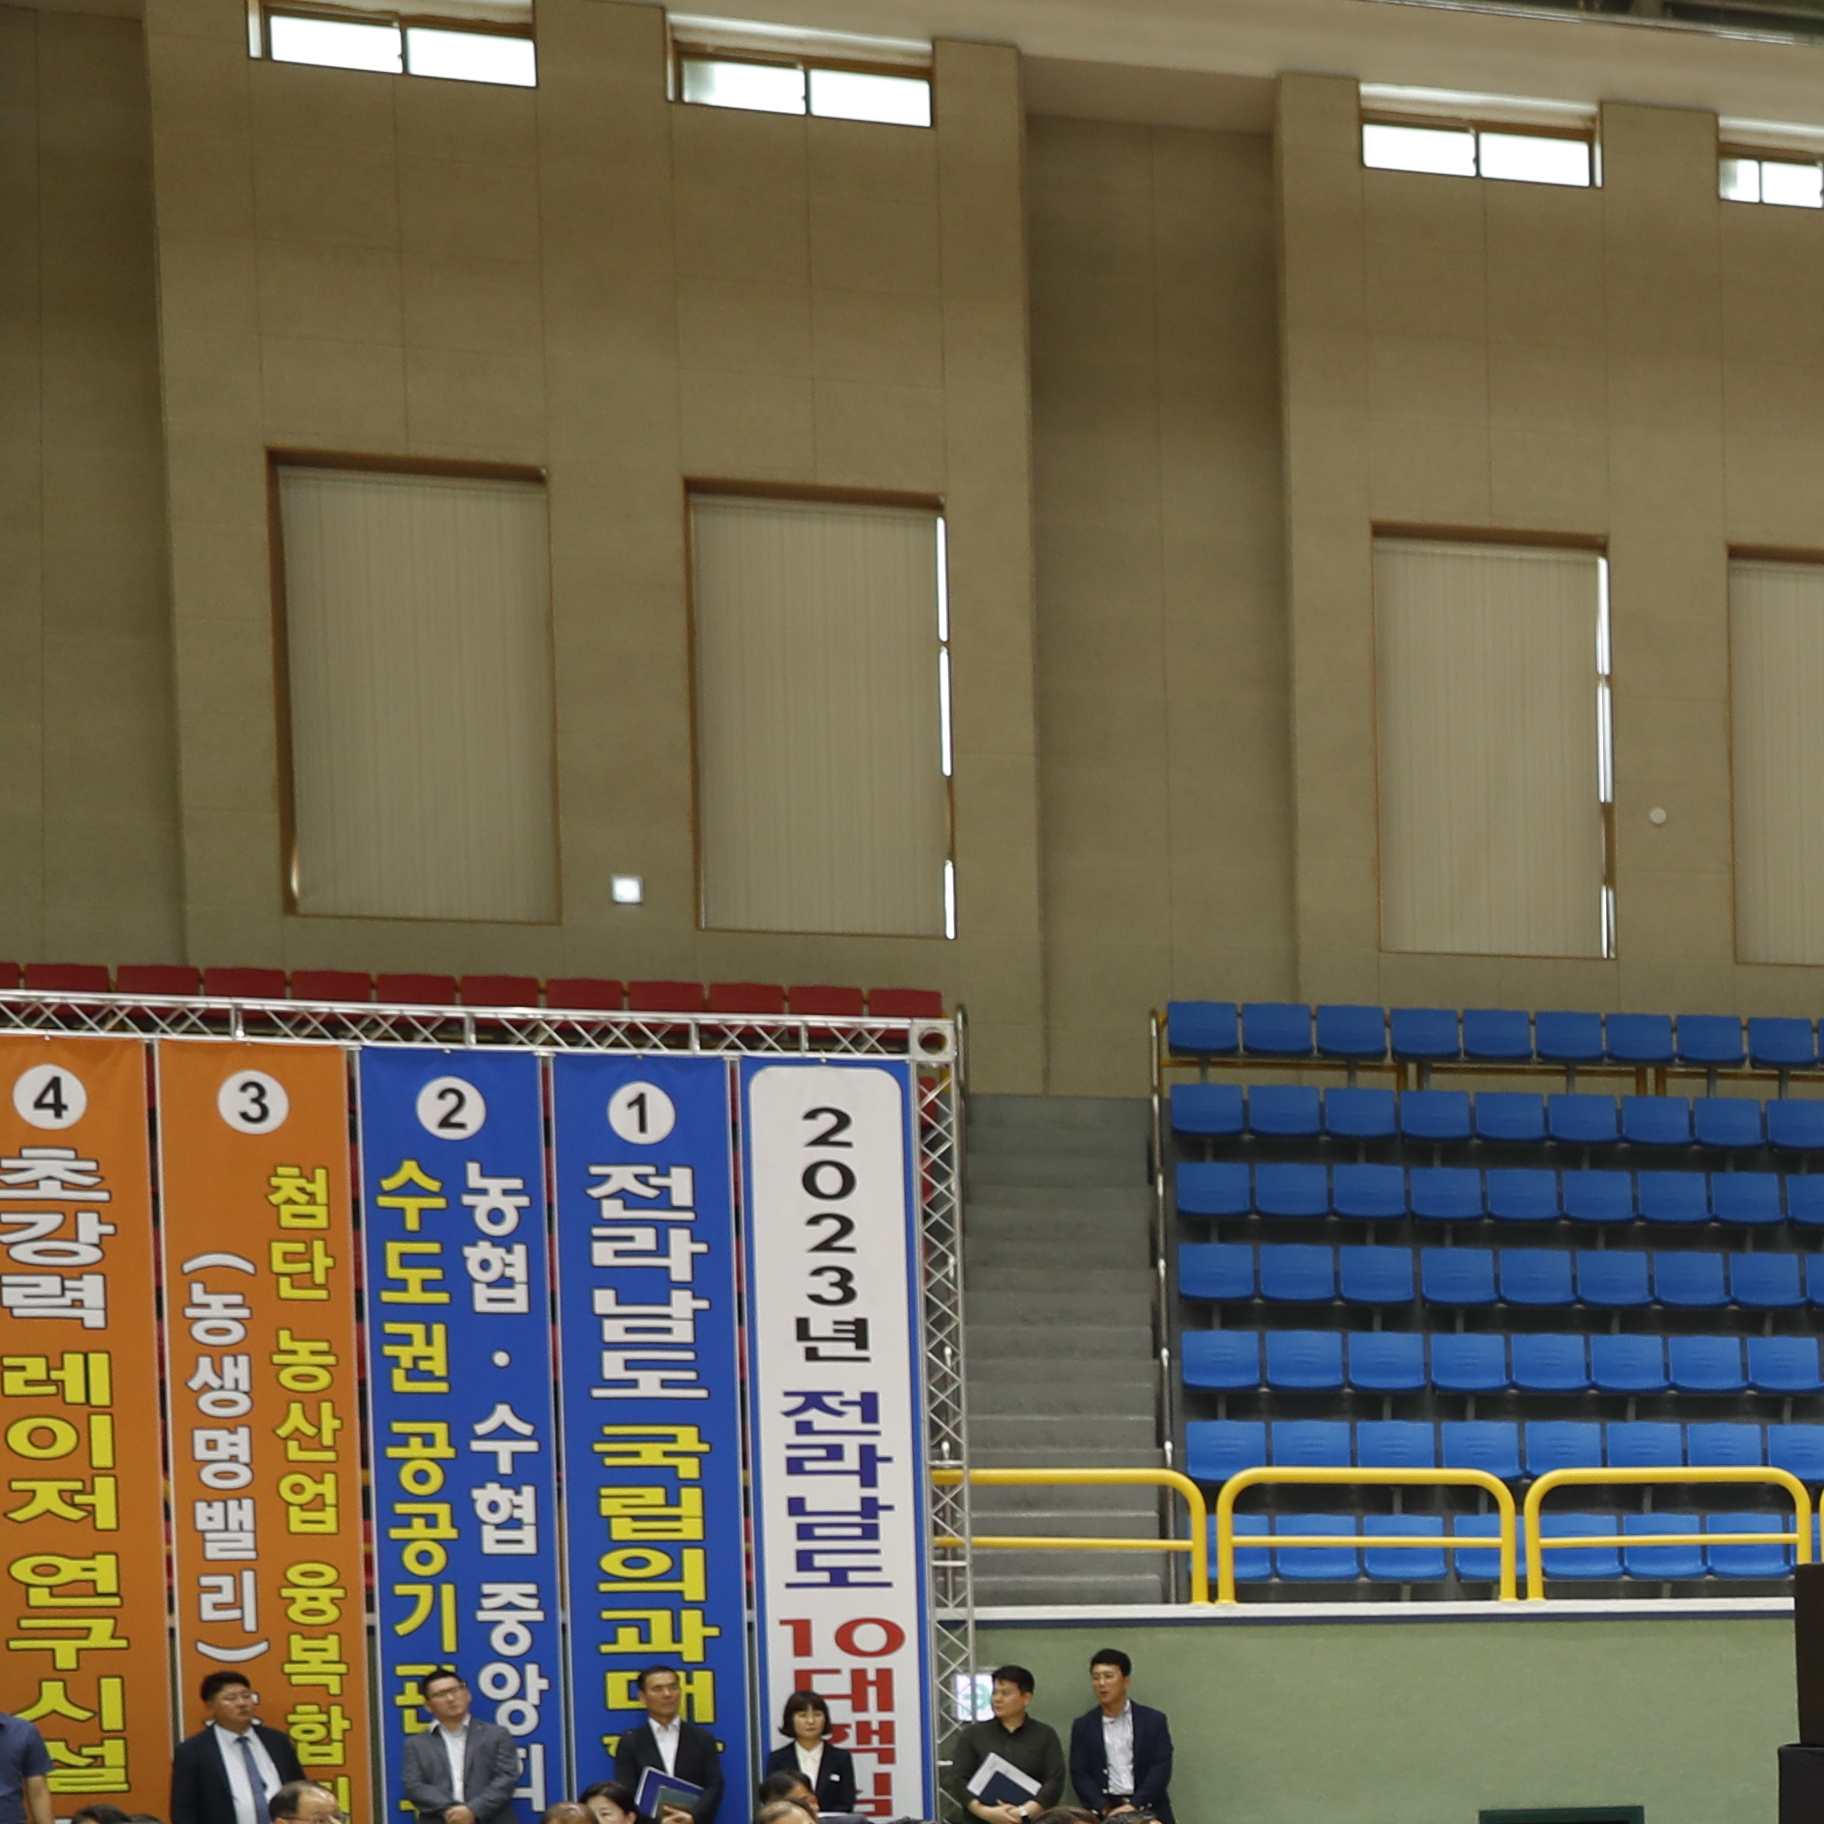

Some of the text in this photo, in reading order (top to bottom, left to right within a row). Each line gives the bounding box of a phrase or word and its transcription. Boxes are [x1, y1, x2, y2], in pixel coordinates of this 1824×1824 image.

[32, 1076, 68, 1120] 4
[238, 1081, 270, 1125] 3
[436, 1087, 466, 1130] 2
[627, 1091, 650, 1135] 1
[267, 1165, 332, 1303] 첨단
[376, 1159, 451, 1394] 수도권
[585, 1162, 710, 1400] 전라남도
[795, 1105, 872, 1365] 2023년
[0, 1145, 131, 1795] 초강력 레이저 연구시설
[182, 1251, 270, 1663] (농생명밸리)
[270, 1330, 343, 1537] 농산업
[778, 1388, 896, 1590] 전라남도
